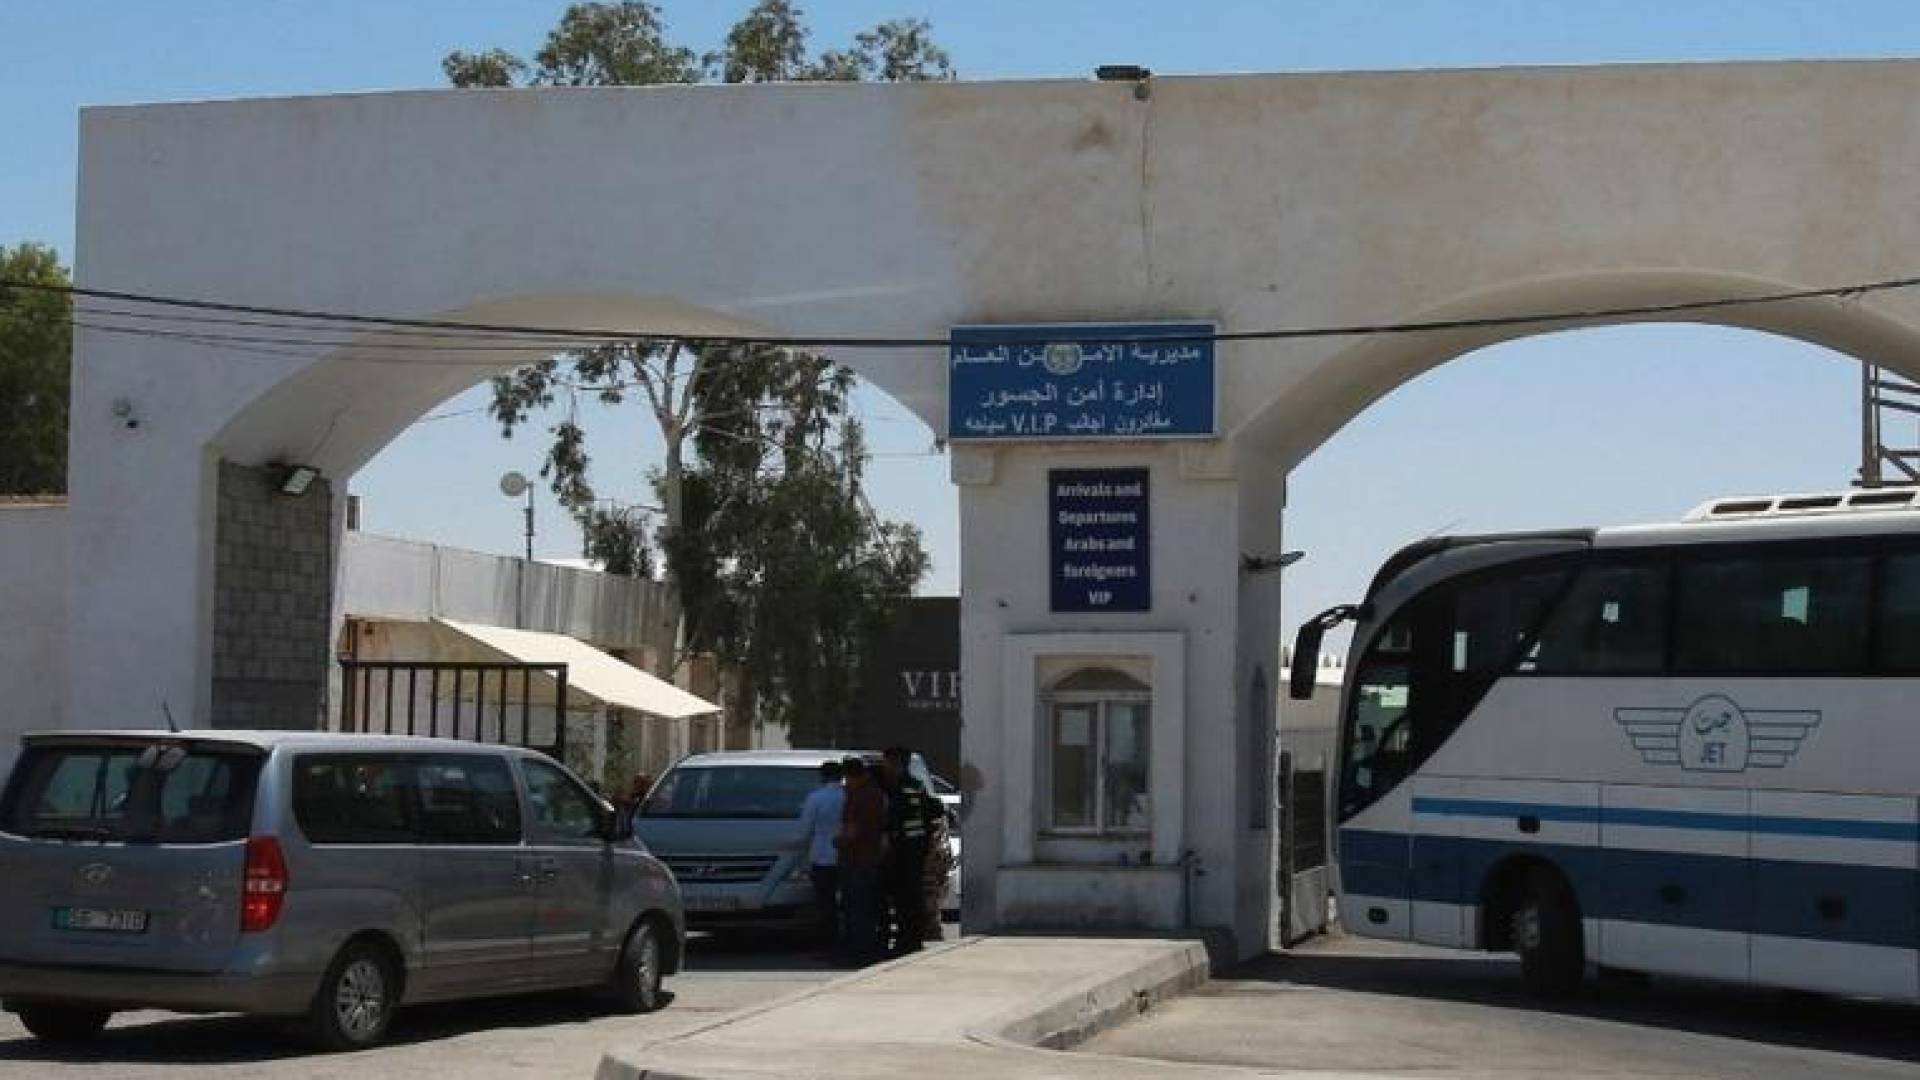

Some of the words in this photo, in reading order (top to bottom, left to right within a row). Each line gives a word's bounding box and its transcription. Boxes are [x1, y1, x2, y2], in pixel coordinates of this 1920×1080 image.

[981, 382, 1057, 407] الجسور
[1066, 378, 1104, 406] أمن
[1012, 413, 1057, 433] V.I.P
[1057, 481, 1111, 496] Arrivals
[1114, 482, 1141, 496] and
[1059, 510, 1137, 526] Departures
[1064, 537, 1105, 551] Arabs
[1106, 537, 1136, 551] and
[1089, 591, 1113, 605] VIP
[1701, 743, 1726, 763] JET
